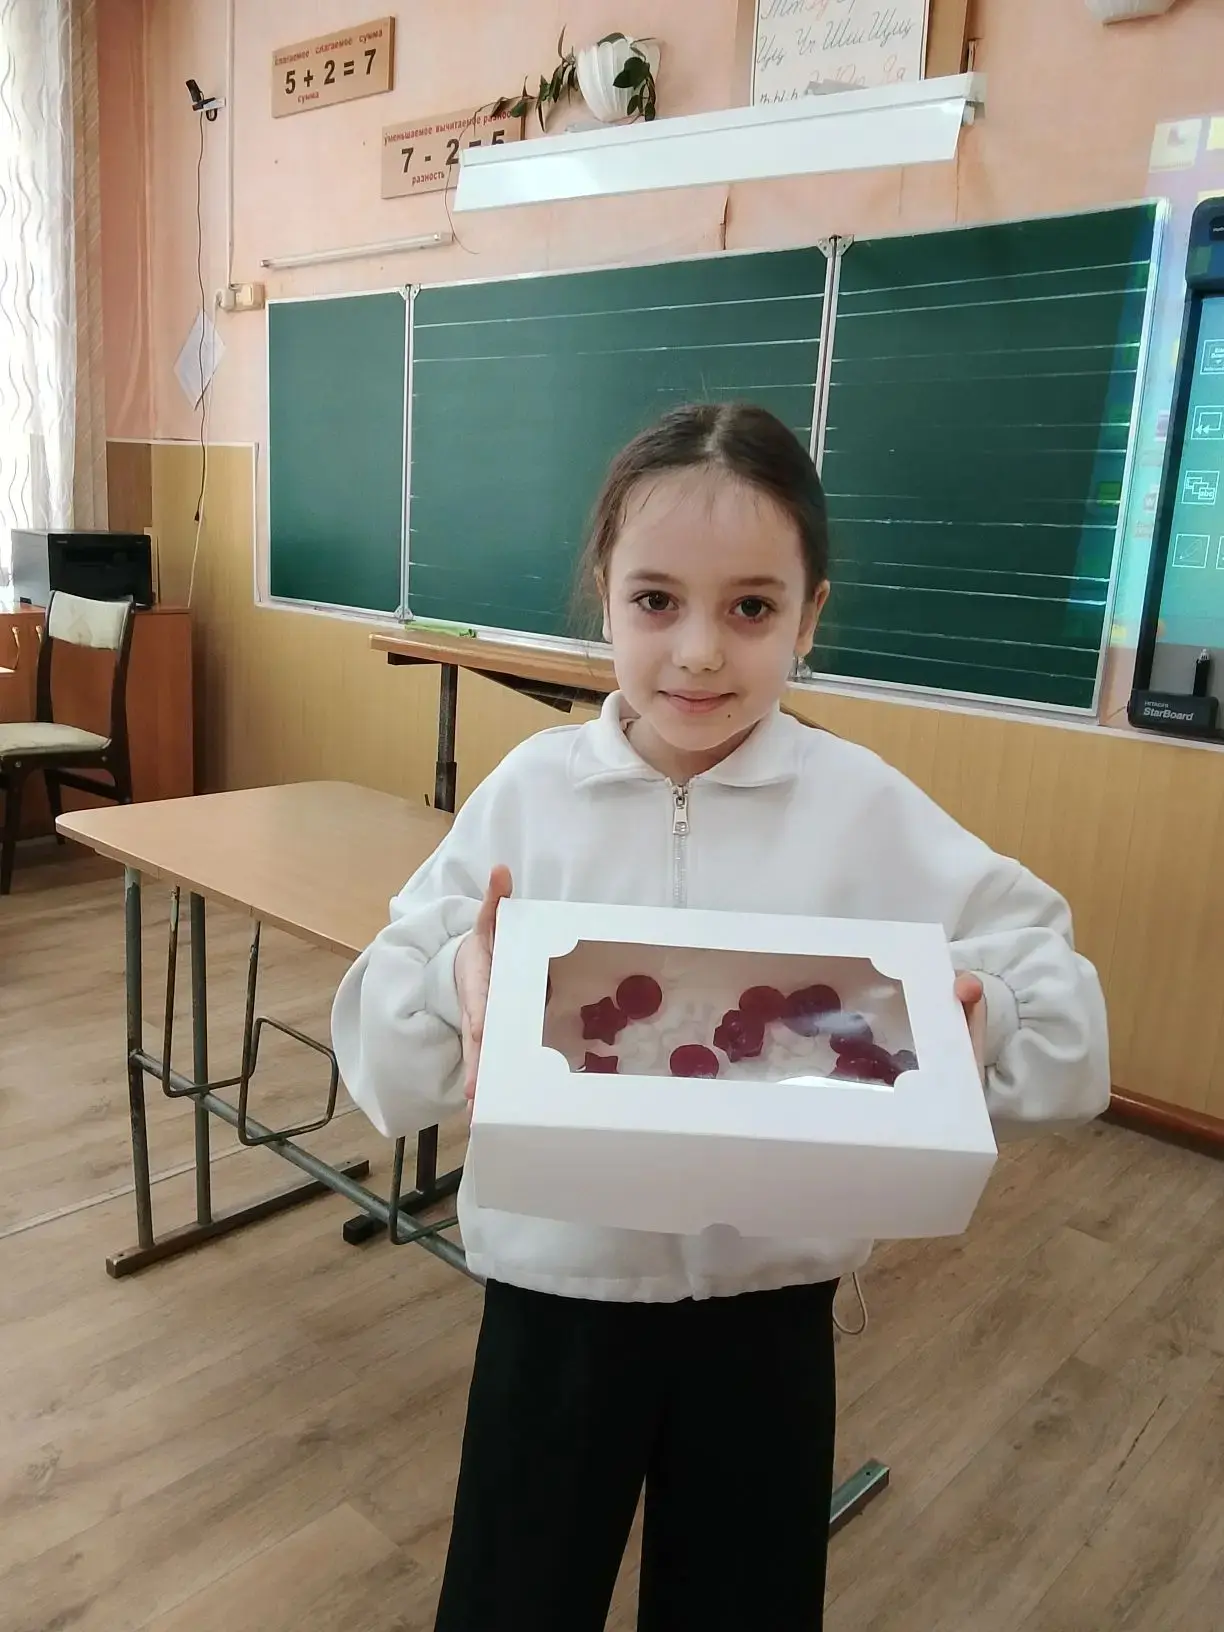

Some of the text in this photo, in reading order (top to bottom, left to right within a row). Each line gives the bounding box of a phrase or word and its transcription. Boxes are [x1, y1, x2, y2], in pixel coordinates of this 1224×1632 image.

[275, 29, 383, 66] слагаемое слагаемое сумма
[285, 69, 296, 94] 5
[324, 60, 335, 85] 2
[365, 48, 376, 75] 7
[297, 91, 320, 104] сумма
[384, 127, 433, 146] уменьшаемое
[436, 116, 481, 132] вычитаемое
[401, 147, 414, 173] 7
[445, 139, 460, 165] 2
[411, 171, 445, 187] разность
[1143, 707, 1194, 721] StarBoard
